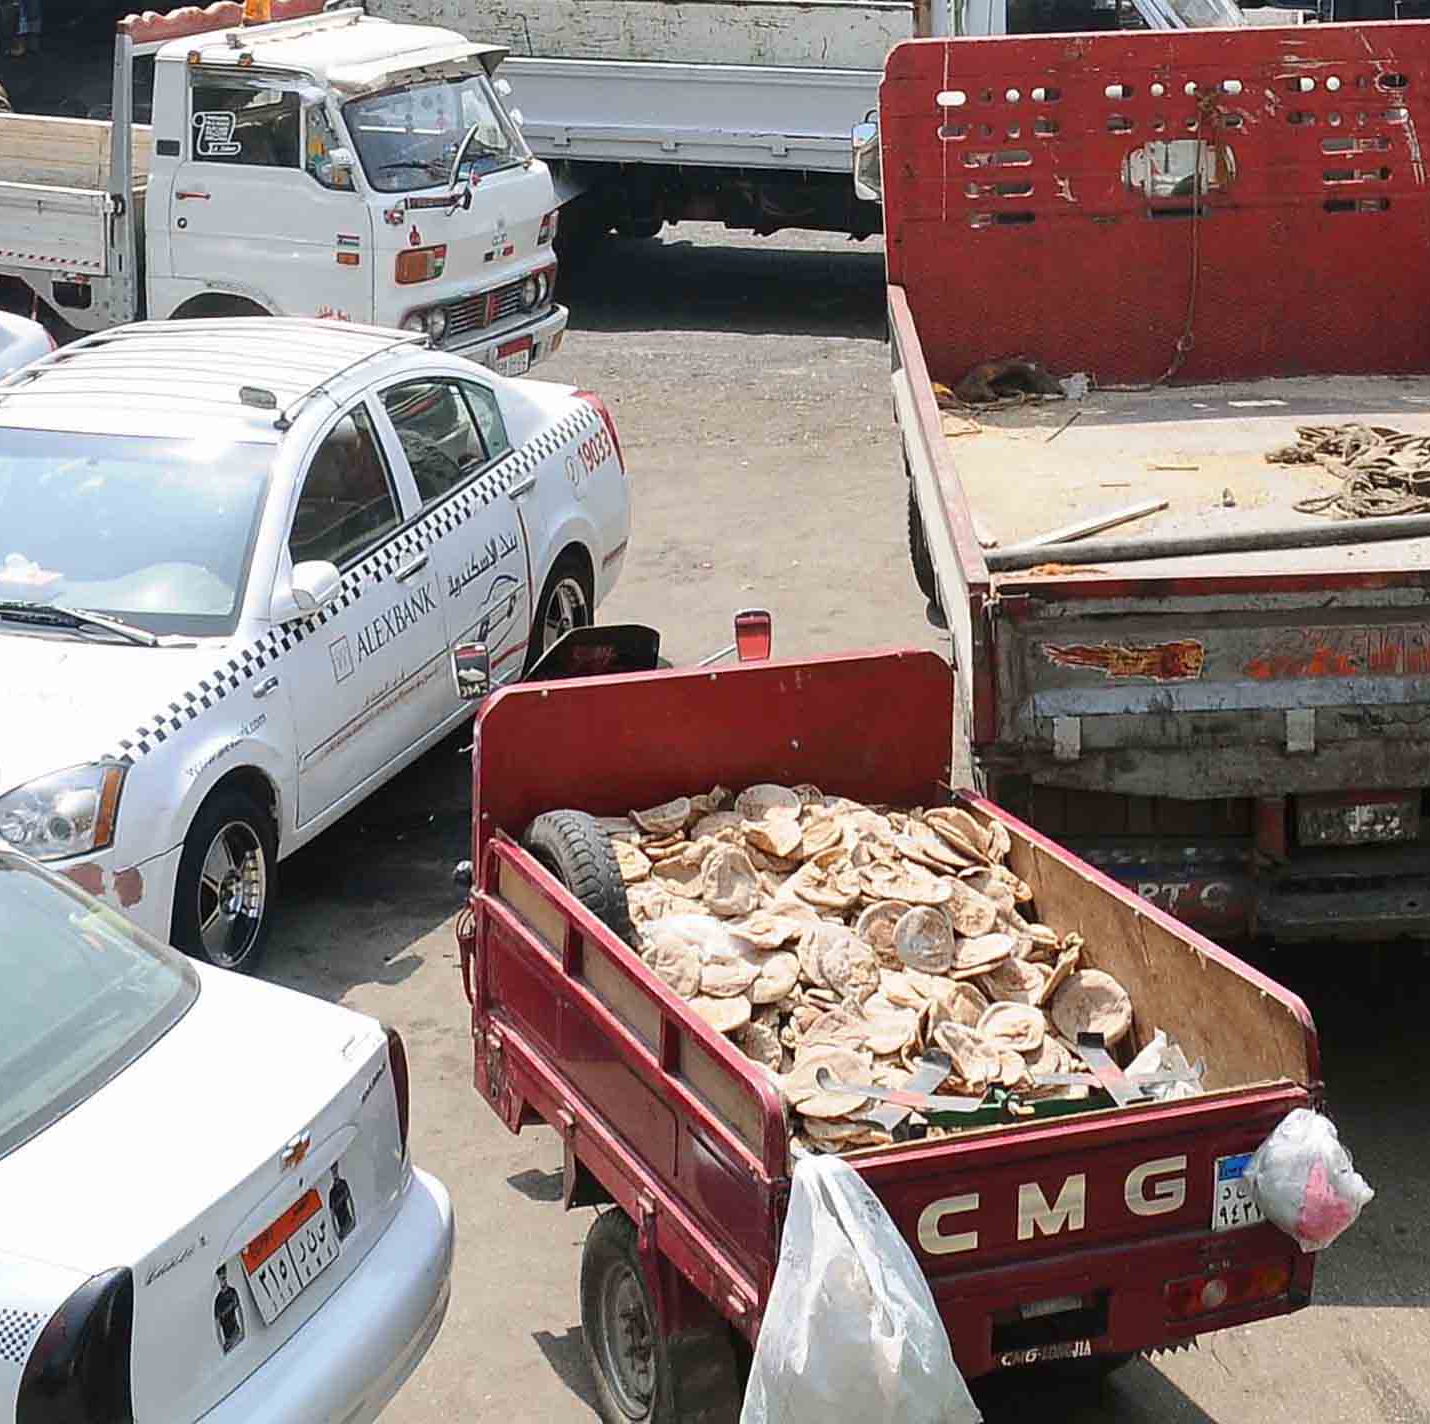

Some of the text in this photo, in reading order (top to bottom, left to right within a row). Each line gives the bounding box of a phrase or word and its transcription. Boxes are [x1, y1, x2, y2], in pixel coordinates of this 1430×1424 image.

[578, 428, 612, 477] 19033
[356, 583, 437, 663] ALEXBANK
[917, 1155, 1188, 1256] CMG
